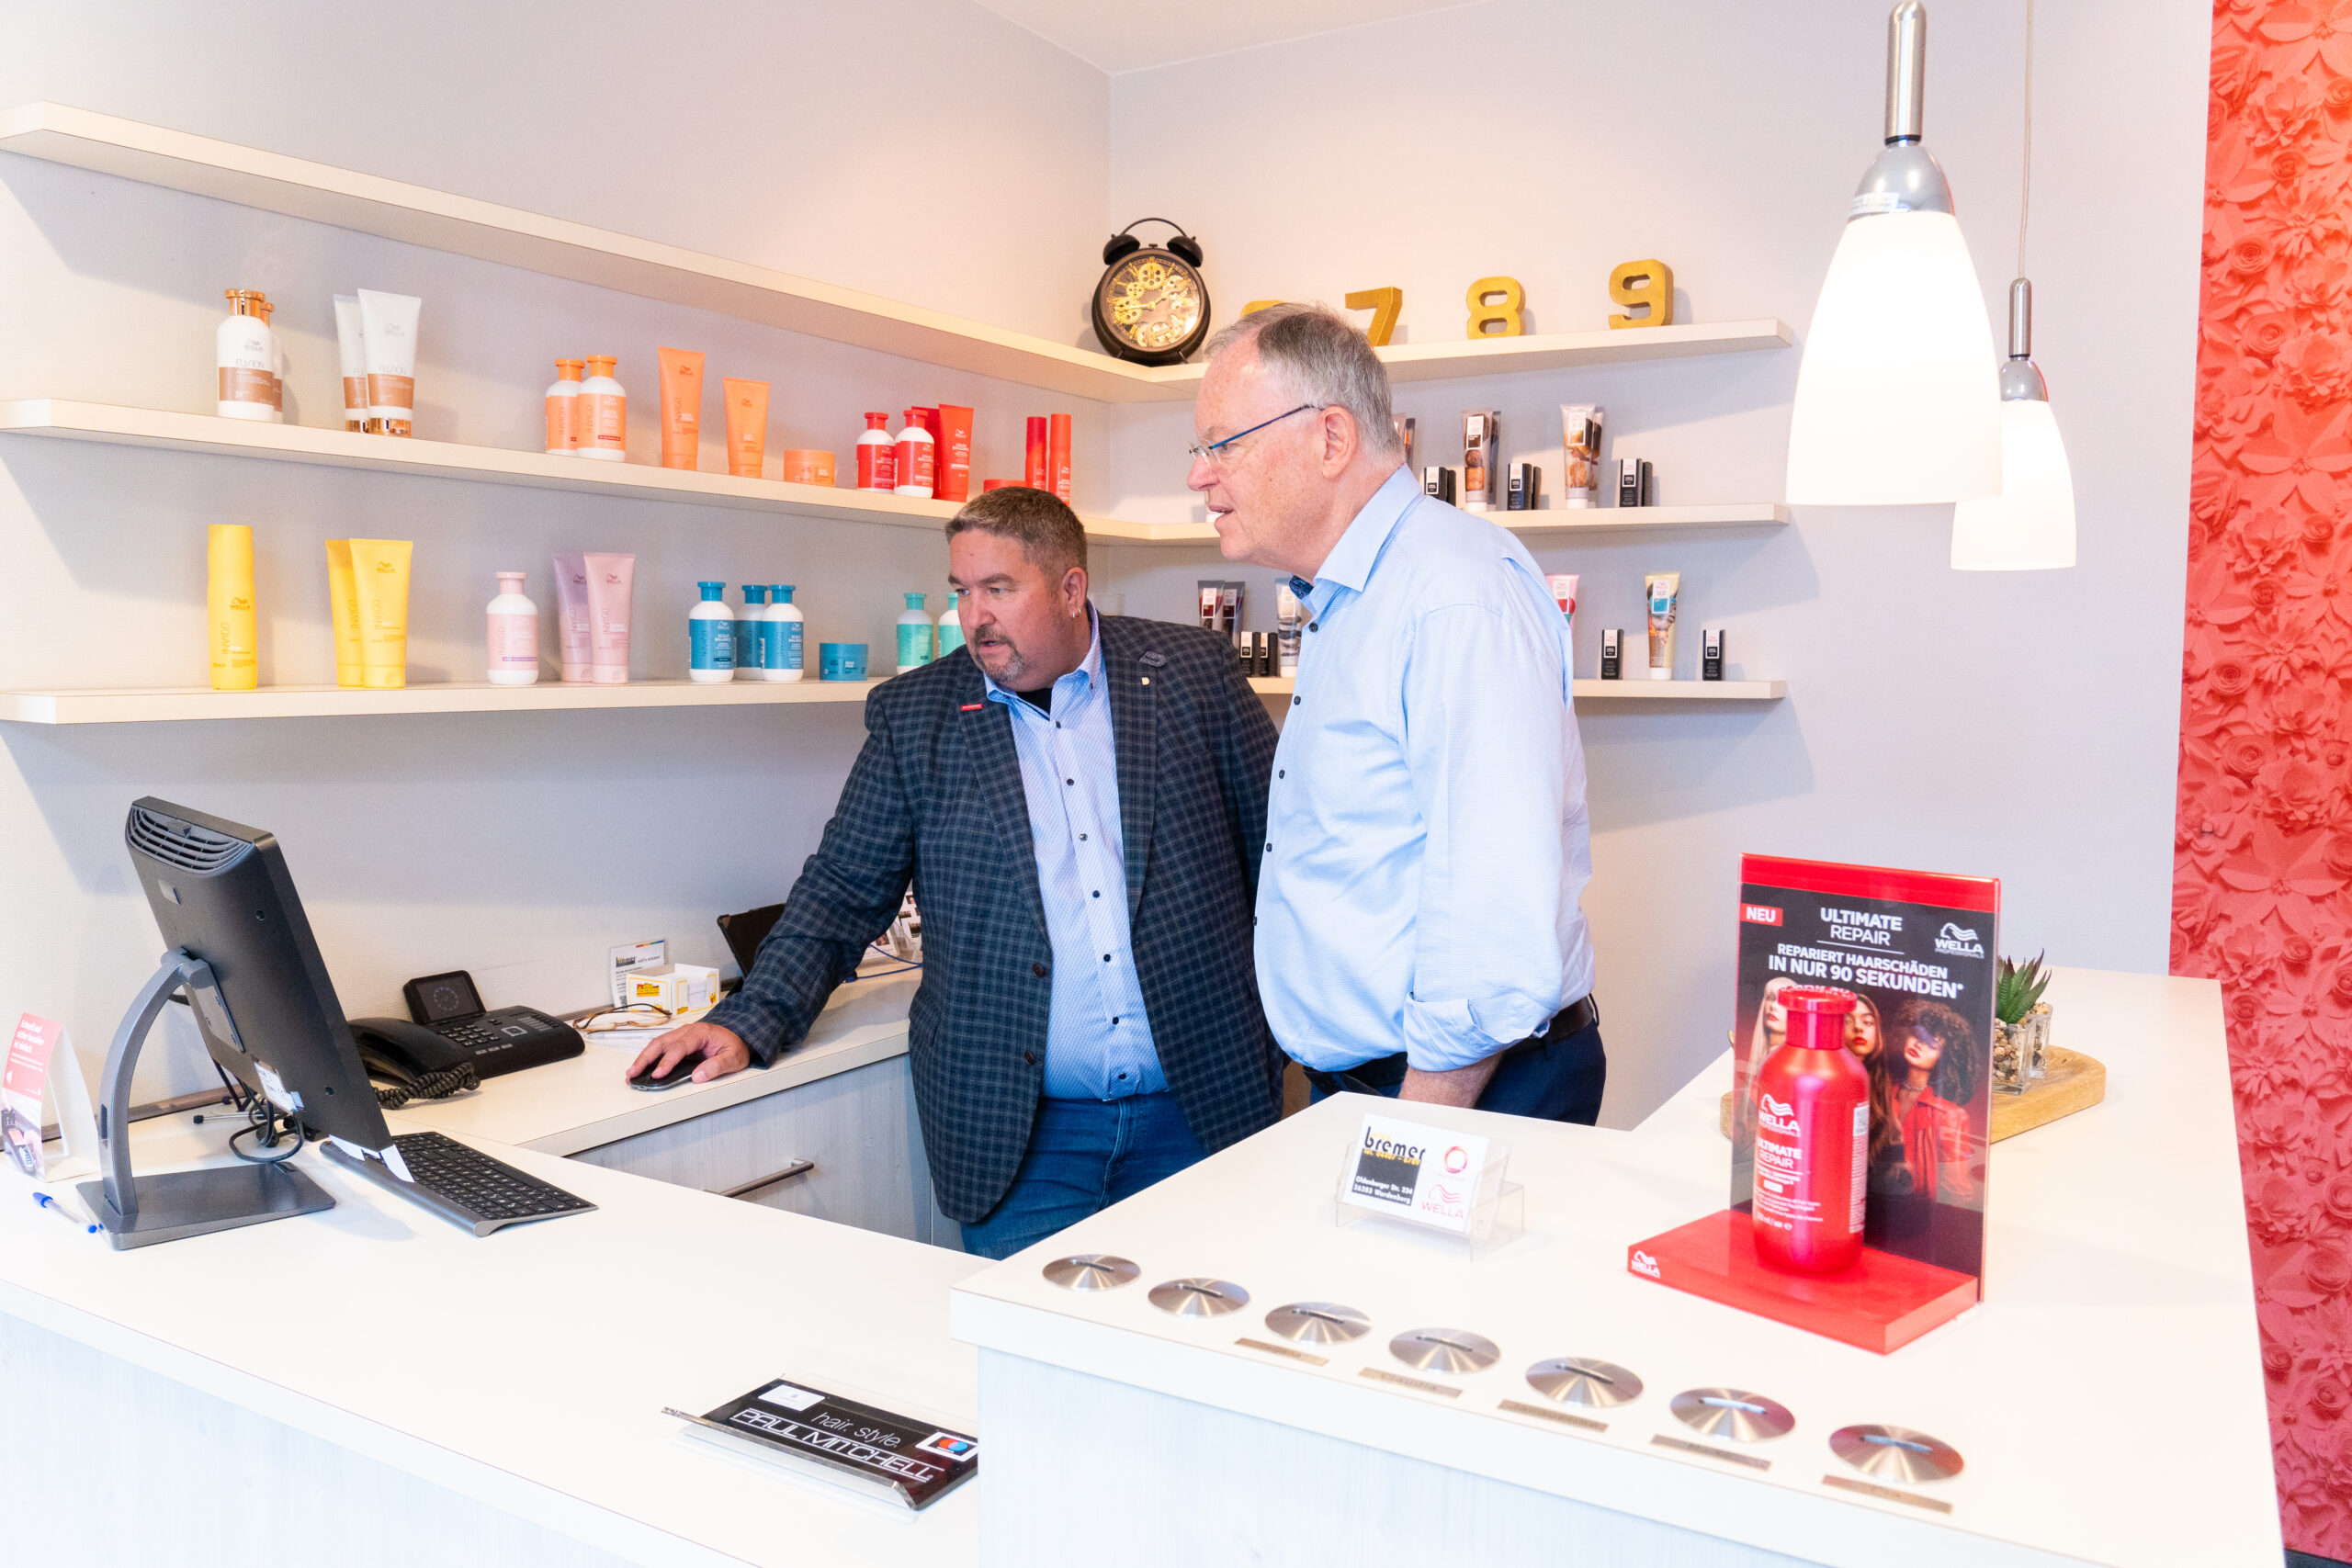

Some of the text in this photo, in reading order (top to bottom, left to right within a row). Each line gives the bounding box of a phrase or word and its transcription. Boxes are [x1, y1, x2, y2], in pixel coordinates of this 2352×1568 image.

[1345, 259, 1674, 347] 7 8 9
[1747, 907, 1776, 923] NEU
[1820, 908, 1903, 931] ULTIMATE
[1830, 925, 1891, 946] REPAIR
[1935, 938, 1984, 954] WELLA
[1769, 954, 1787, 972] IN
[1791, 957, 1827, 979] NUR
[1830, 965, 1853, 982] 90
[1777, 942, 1949, 980] REPARIERT HAARSCHÄDEN
[1758, 1110, 1801, 1133] WELLA
[1364, 1126, 1426, 1160] bremer
[1759, 1148, 1794, 1169] REPAIR
[1355, 1175, 1390, 1190] Oldenburger
[1374, 1189, 1411, 1205] Wardenburg
[1421, 1201, 1464, 1219] WELLA
[1631, 1258, 1661, 1278] WELLA
[811, 1412, 901, 1449] hair. style.
[733, 1409, 935, 1481] PAUL MITCHELL
